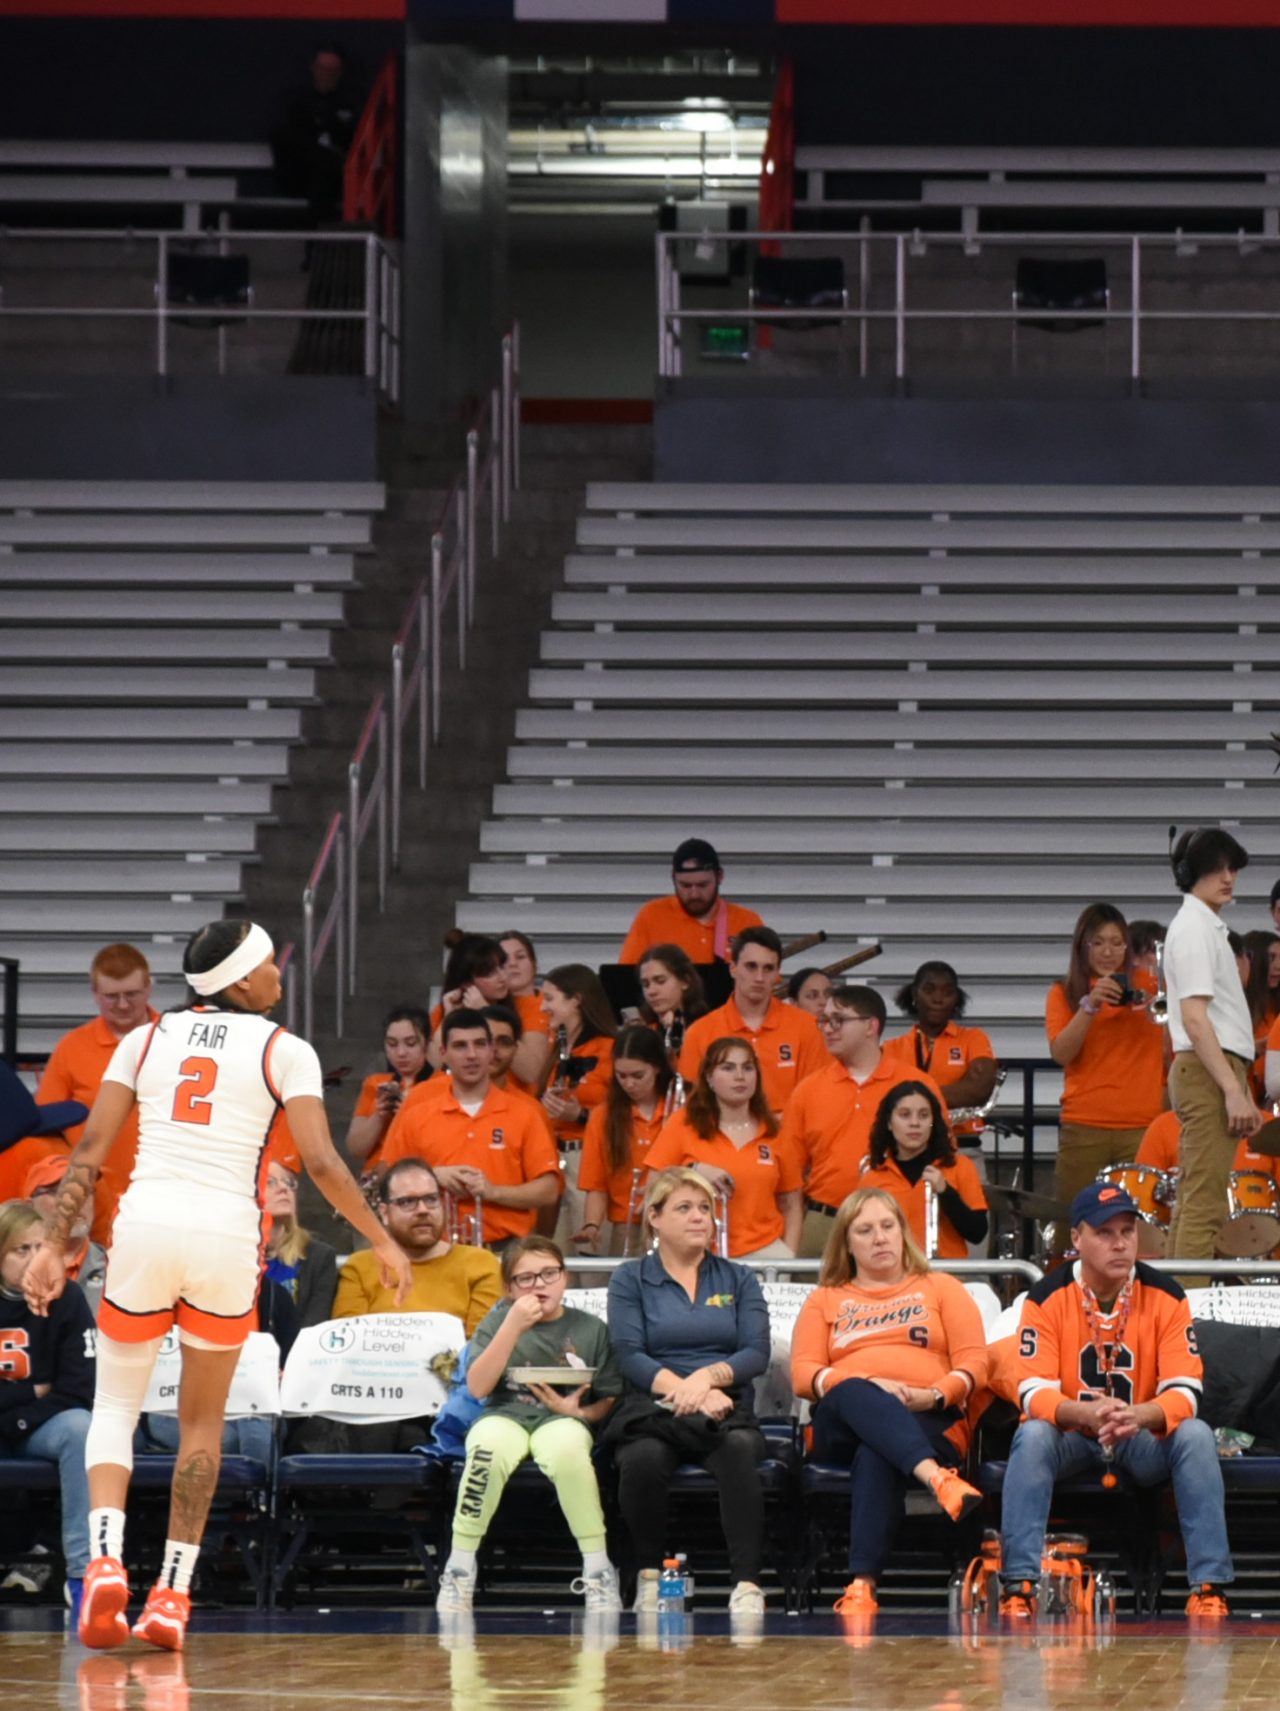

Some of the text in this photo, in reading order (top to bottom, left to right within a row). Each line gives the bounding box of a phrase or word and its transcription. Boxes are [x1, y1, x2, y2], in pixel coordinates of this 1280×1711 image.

[187, 1022, 229, 1050] FAIR
[779, 1044, 792, 1061] S
[950, 1047, 962, 1061] S
[171, 1055, 219, 1126] 2
[491, 1127, 504, 1145] S
[757, 1145, 771, 1161] S
[833, 1305, 930, 1338] Orange
[363, 1329, 422, 1342] Hidden
[1019, 1327, 1038, 1359] S
[362, 1341, 406, 1353] Level
[331, 1384, 404, 1399] CRTS A 110
[460, 1444, 494, 1519] JUSTICE
